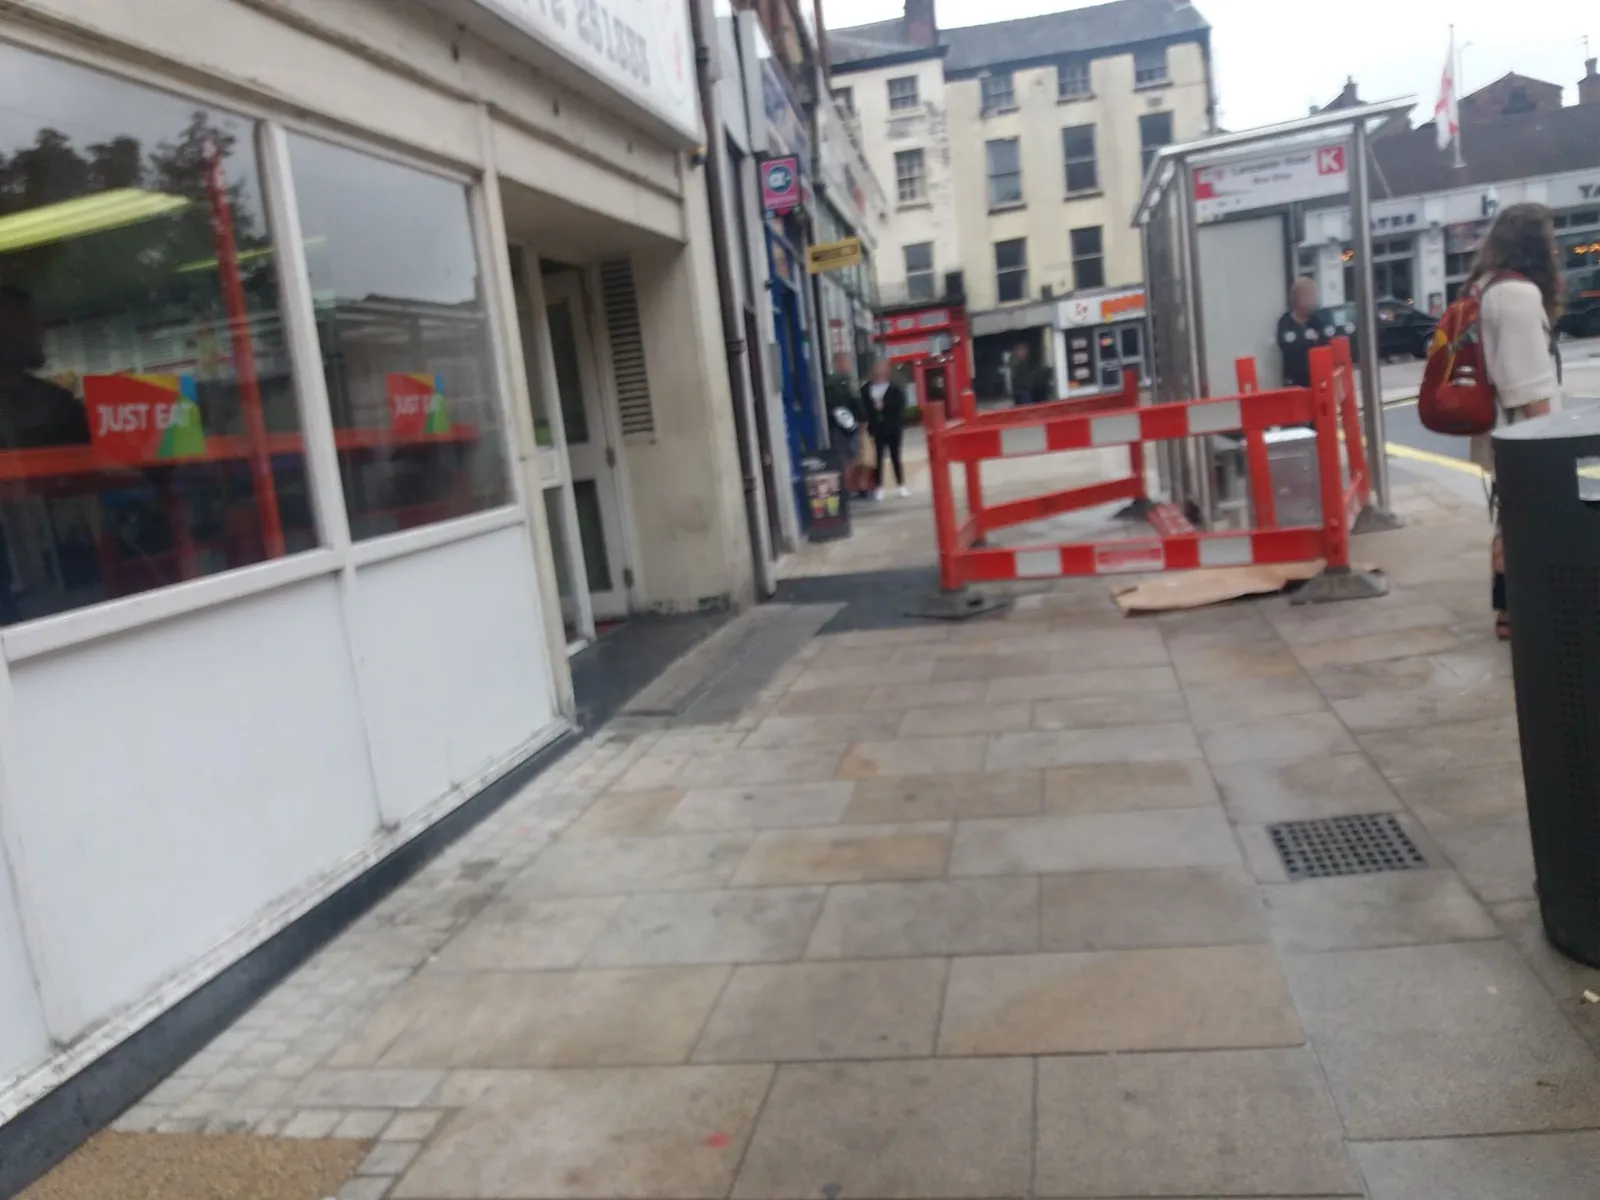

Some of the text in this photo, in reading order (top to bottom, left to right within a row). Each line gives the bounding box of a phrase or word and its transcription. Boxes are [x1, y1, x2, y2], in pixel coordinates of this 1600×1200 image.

[1320, 150, 1340, 173] K
[96, 401, 193, 437] JUST EAT
[394, 393, 420, 419] JUST
